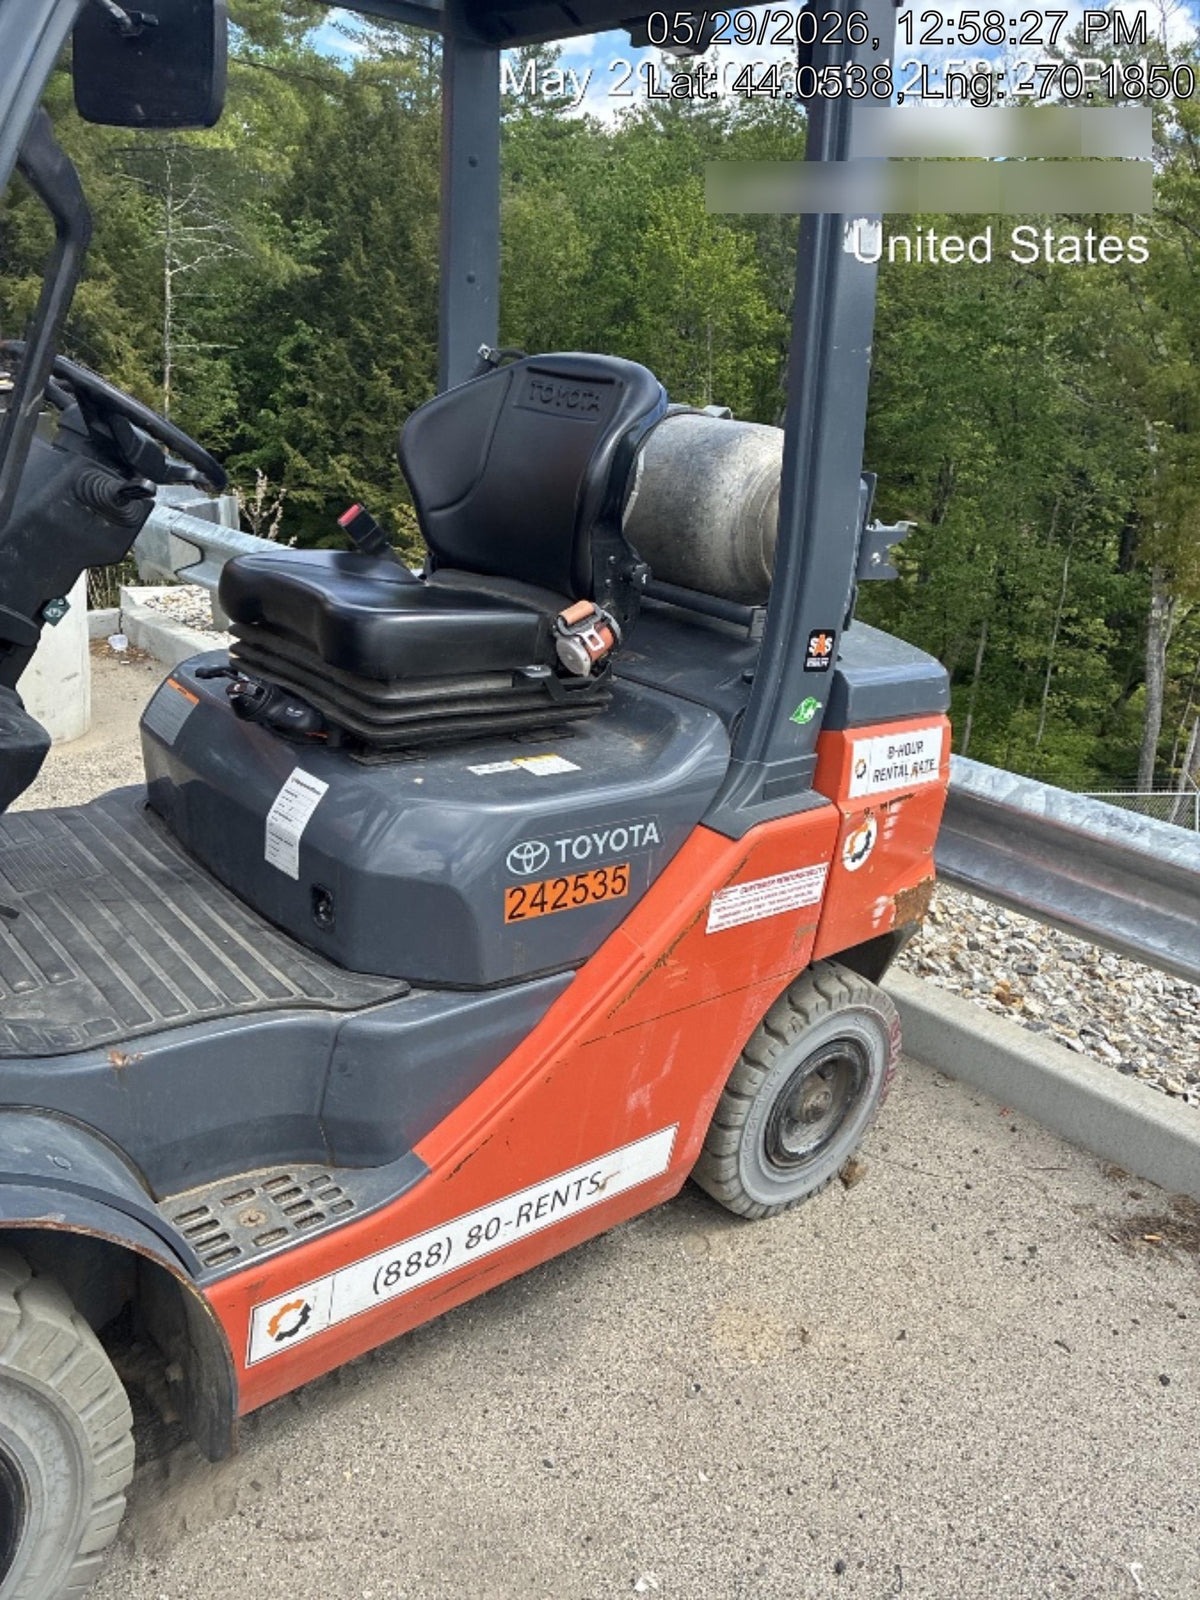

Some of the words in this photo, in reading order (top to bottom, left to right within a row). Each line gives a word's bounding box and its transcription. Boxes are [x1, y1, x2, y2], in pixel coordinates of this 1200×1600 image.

[529, 380, 601, 412] TOYOTA
[872, 763, 909, 783] RENTAL
[554, 821, 661, 863] TOYOTA
[507, 865, 627, 920] 242535
[372, 1236, 453, 1295] (888)
[464, 1170, 602, 1250] 80-RENTS
